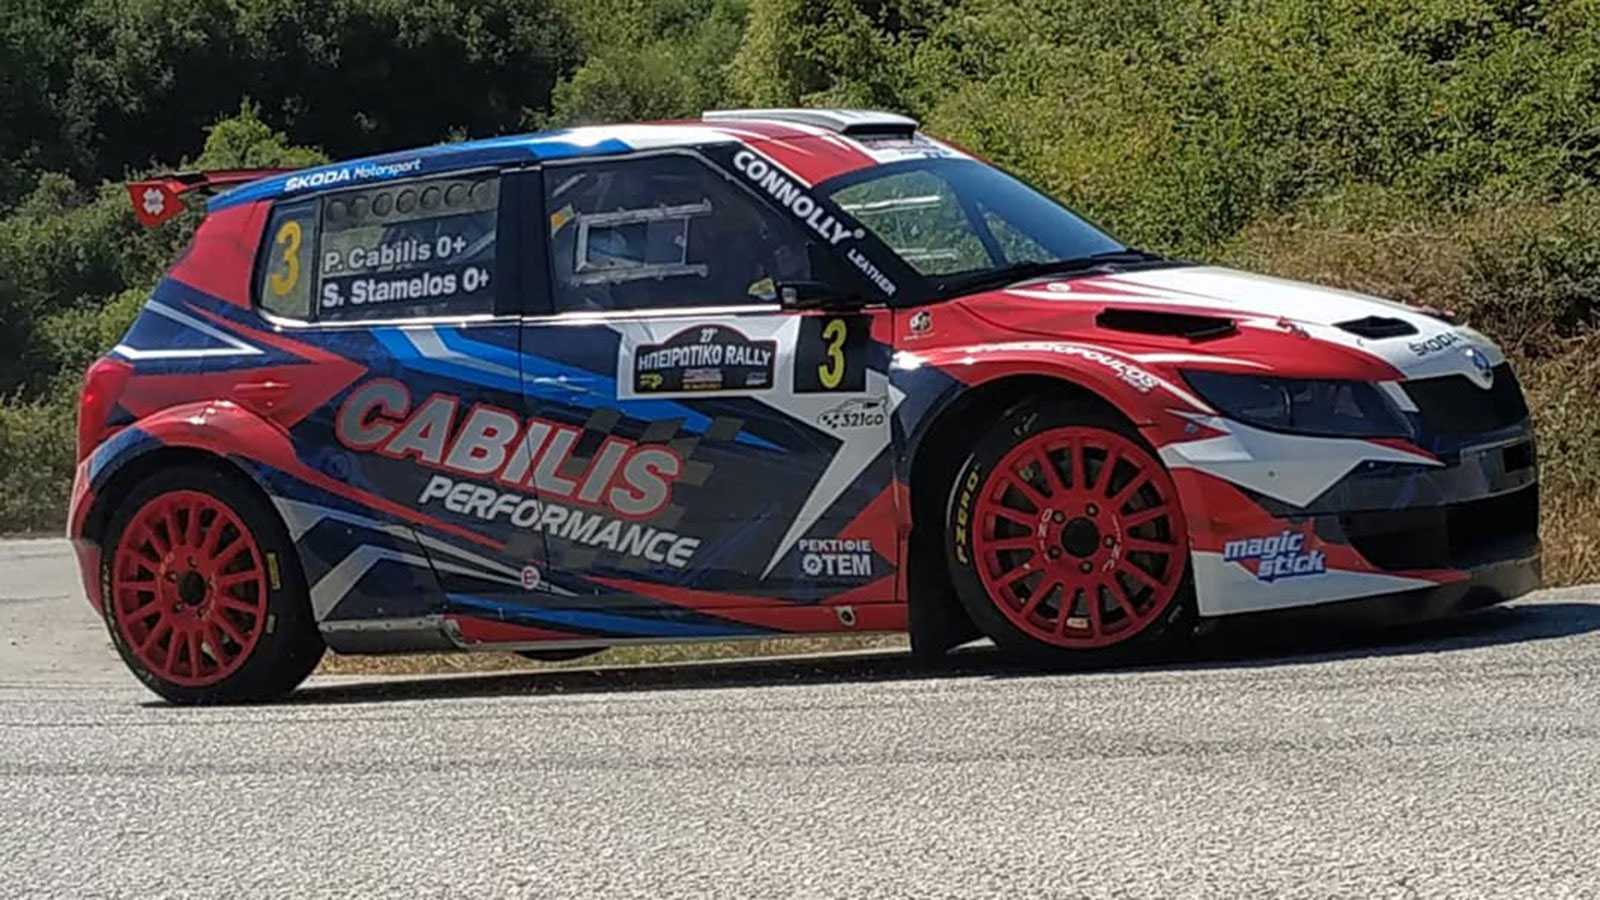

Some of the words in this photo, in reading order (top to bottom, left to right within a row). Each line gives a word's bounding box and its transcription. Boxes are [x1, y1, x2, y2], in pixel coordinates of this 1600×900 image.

[353, 158, 422, 181] Motorsport
[271, 220, 302, 294] 3
[324, 250, 343, 272] P.
[348, 240, 431, 268] Cabilis
[846, 248, 897, 297] LEATHER
[322, 282, 345, 307] S.
[350, 273, 457, 304] Stamelos
[724, 344, 772, 367] RALLY
[818, 319, 847, 388] 3
[336, 379, 684, 519] CABILIS
[418, 475, 700, 567] PERFORMANCE
[1224, 530, 1305, 559] magic
[1258, 550, 1325, 577] stick
